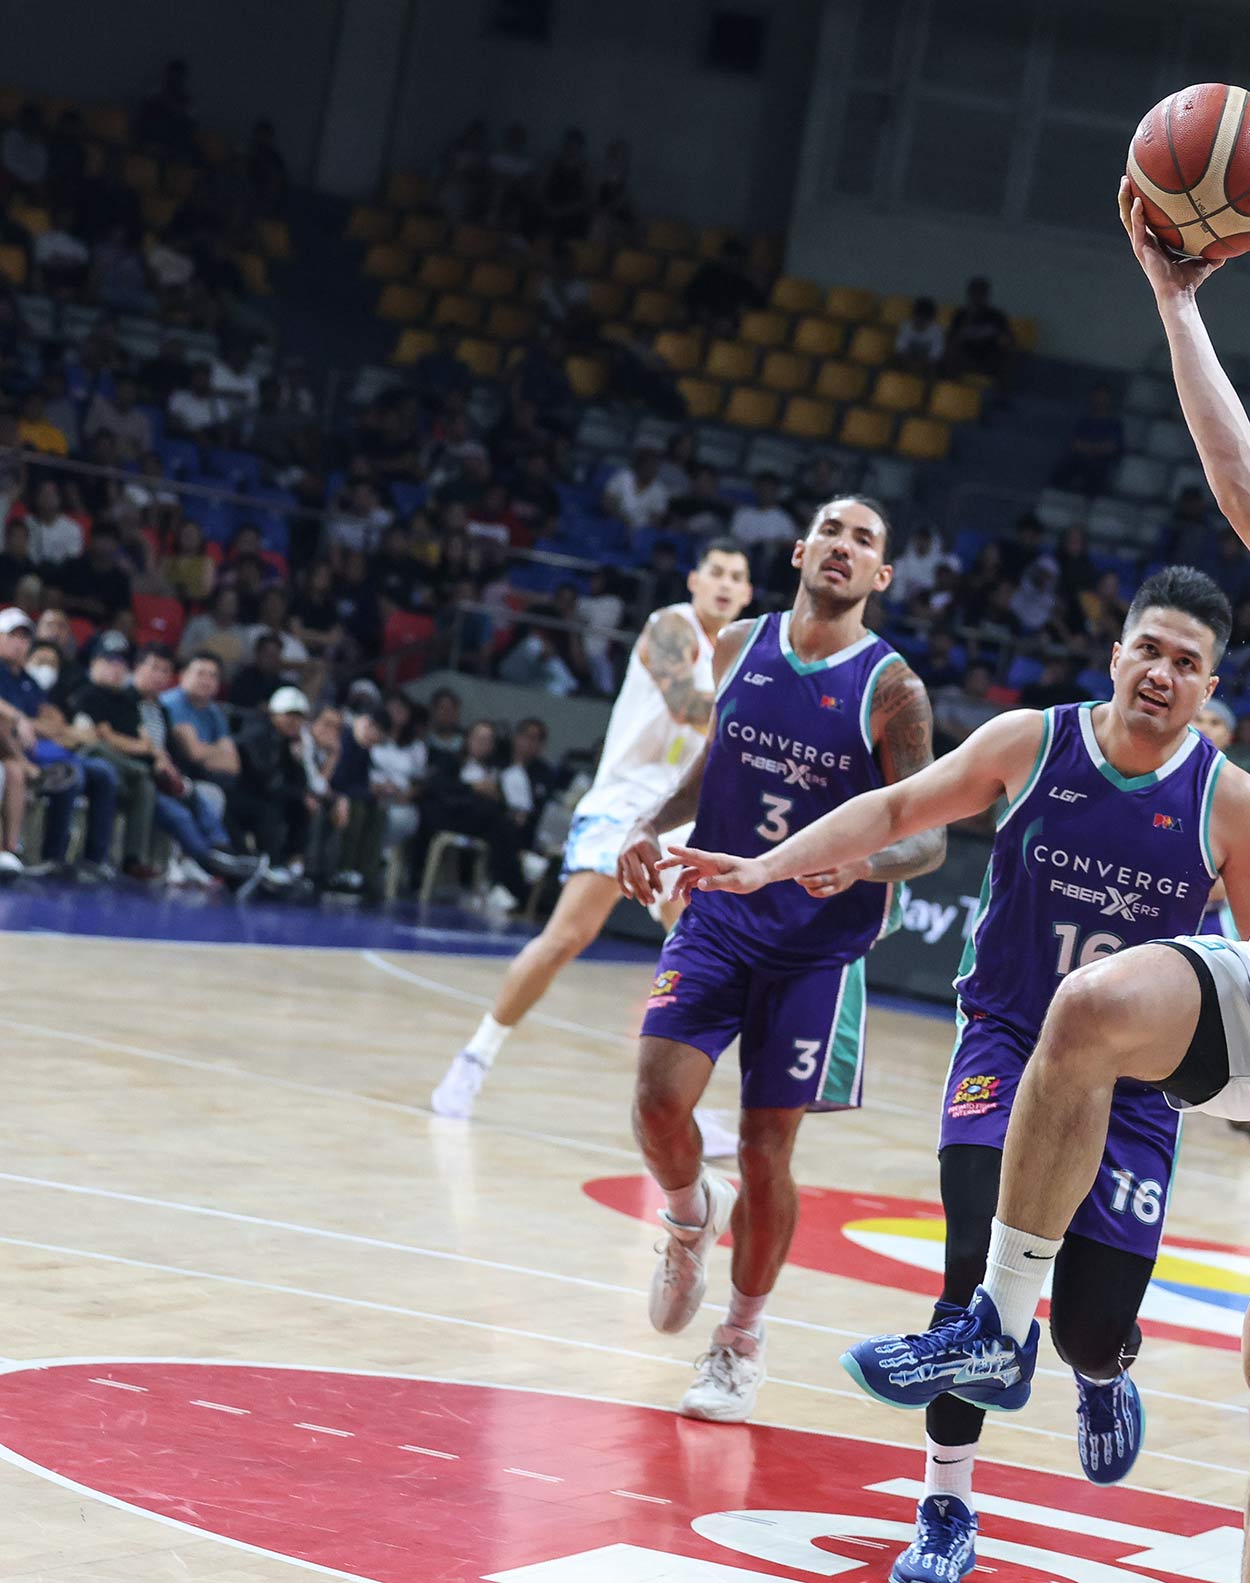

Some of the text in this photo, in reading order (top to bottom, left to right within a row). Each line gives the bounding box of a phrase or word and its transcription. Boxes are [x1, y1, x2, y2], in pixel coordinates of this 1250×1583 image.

[727, 721, 851, 770] CONVERGE
[756, 793, 793, 842] 3
[1034, 845, 1190, 899] CONVERGE
[788, 1039, 821, 1080] 3
[1110, 1168, 1163, 1226] 16
